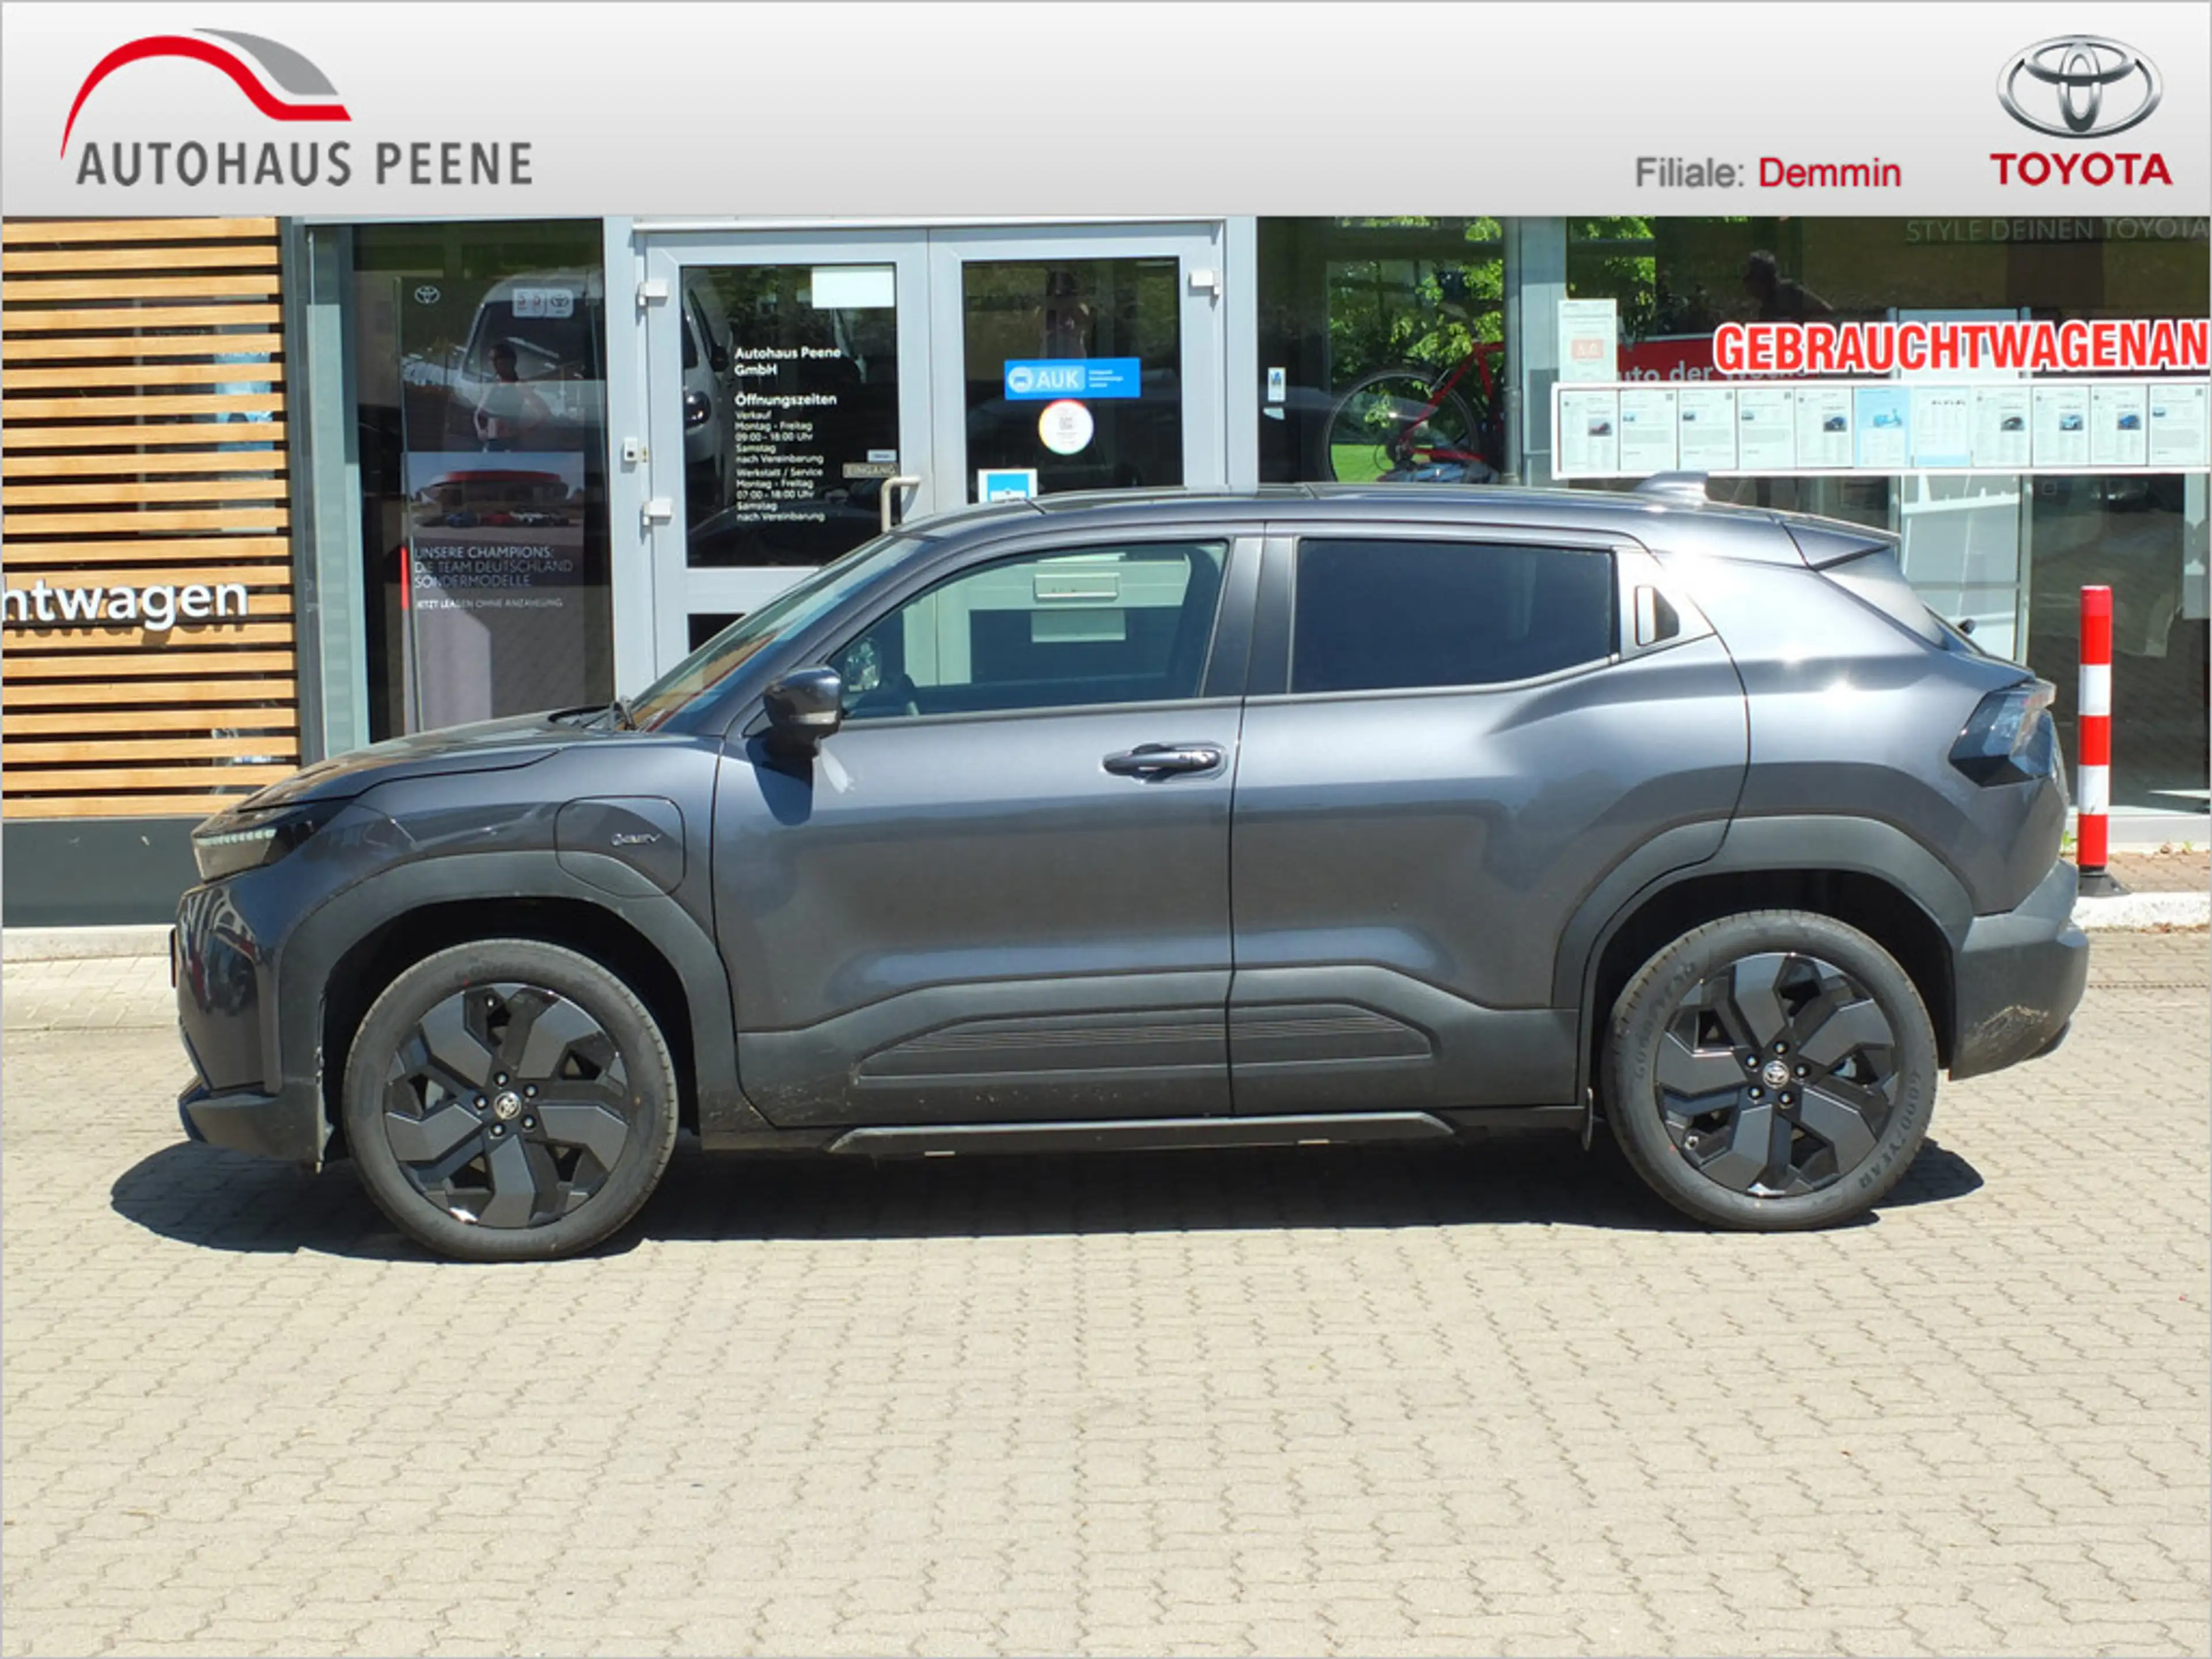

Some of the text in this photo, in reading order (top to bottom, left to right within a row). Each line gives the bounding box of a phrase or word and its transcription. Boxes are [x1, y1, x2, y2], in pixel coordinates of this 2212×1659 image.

[1906, 217, 2209, 242] STYLE DEINEN TOYOTA
[1715, 321, 2209, 372] GEBRAUCHTWAGENAN
[734, 346, 842, 359] Autohaus Peene
[734, 363, 778, 376] GmbH
[1037, 370, 1079, 389] AUK
[734, 391, 837, 408] Öffnungszeiten
[735, 410, 772, 420] Verkauf
[734, 421, 772, 432] Montag
[779, 421, 813, 432] Freitag
[797, 432, 813, 442] Uhr
[736, 443, 777, 454] Samstag
[736, 454, 824, 465] nach Vereinbarung
[736, 468, 781, 478] Werkstatt
[790, 467, 824, 477] Service
[736, 479, 772, 489] Montag
[781, 478, 814, 490] Freitag
[797, 490, 815, 499] Uhr
[736, 501, 778, 512] Samstag
[736, 512, 826, 522] nach Vereinbarung
[415, 547, 464, 558] UNSERE
[439, 560, 472, 573] TEAM
